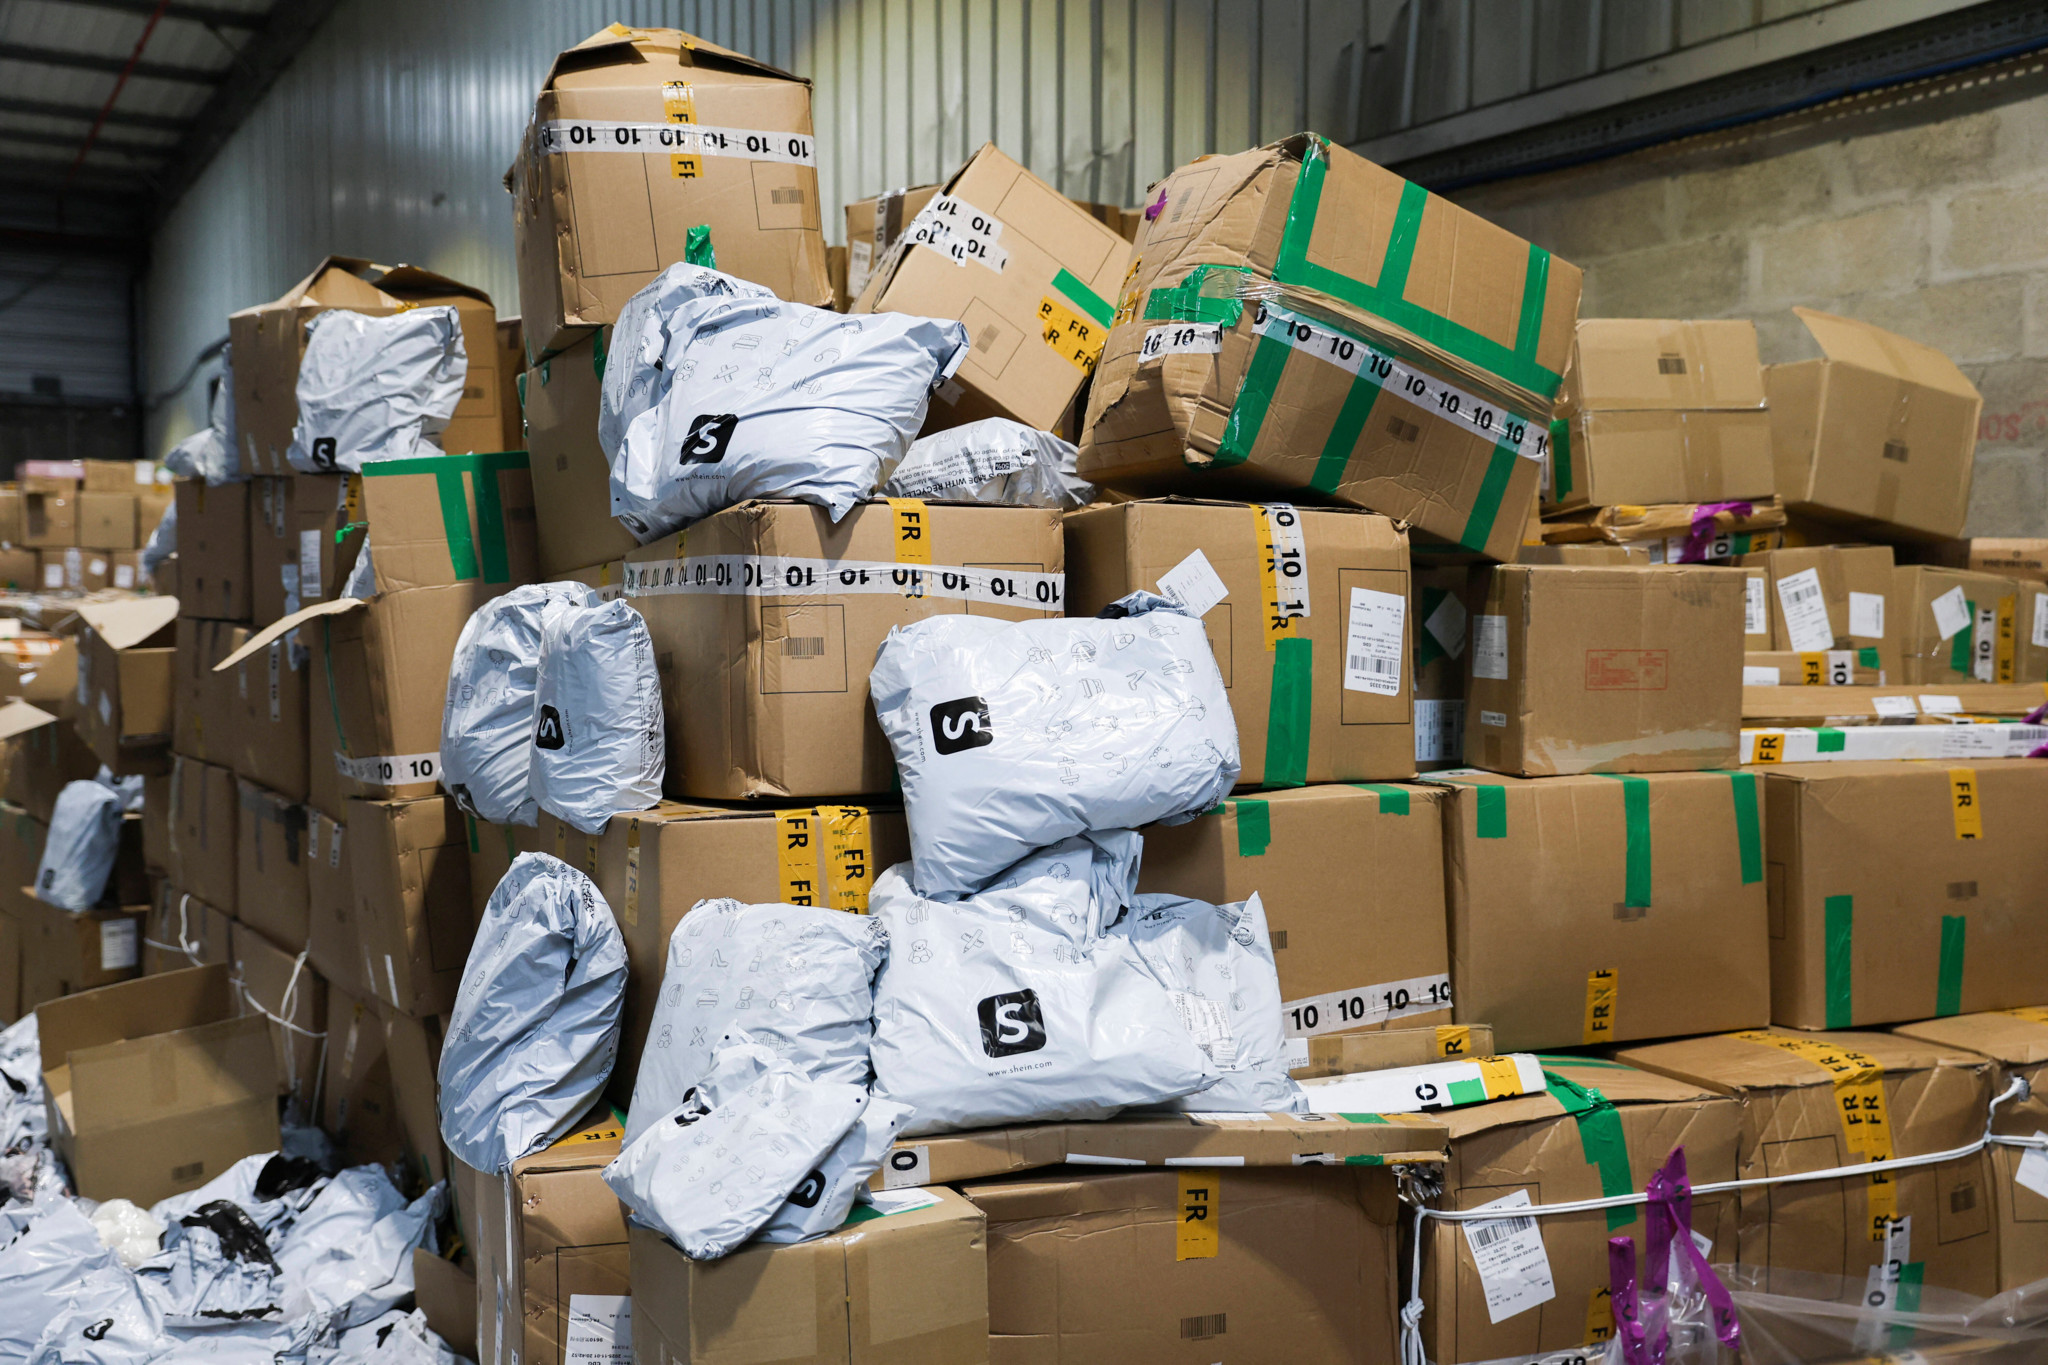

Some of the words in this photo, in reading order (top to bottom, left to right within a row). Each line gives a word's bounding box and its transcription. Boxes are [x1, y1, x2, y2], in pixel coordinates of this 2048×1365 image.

[570, 126, 596, 145] 10
[615, 128, 641, 145] 10
[659, 129, 685, 146] 10
[747, 136, 771, 154] 10
[788, 139, 808, 159] 10
[937, 201, 957, 216] 10
[971, 216, 992, 236] 10
[967, 239, 986, 258] 10
[1068, 320, 1089, 341] FR
[1174, 329, 1195, 346] 10
[1074, 349, 1094, 370] FR
[1286, 320, 1312, 343] 10
[1329, 336, 1355, 361] 10
[1369, 354, 1393, 379] 10
[1404, 374, 1426, 397] 10
[1438, 391, 1460, 414] 10
[1472, 407, 1493, 430] 10
[1505, 421, 1525, 445] 10
[692, 422, 721, 455] S
[945, 478, 965, 487] WITH
[900, 511, 921, 541] FR
[1266, 545, 1284, 573] FR
[1282, 548, 1301, 577] 10
[696, 564, 707, 586] 10
[716, 563, 733, 586] 10
[744, 562, 764, 587] 10
[786, 566, 817, 586] 10
[839, 568, 871, 585] 10
[892, 568, 921, 587] 10
[941, 571, 970, 591] 10
[990, 577, 1018, 598] 10
[1036, 580, 1061, 604] 10
[1270, 602, 1289, 630] FR
[2002, 616, 2011, 639] FR
[1978, 641, 1991, 661] 10
[1806, 661, 1819, 685] FR
[1834, 661, 1847, 685] 10
[2001, 658, 2011, 680] FR
[915, 712, 926, 762] www.shein.com
[942, 711, 980, 740] S
[1759, 736, 1778, 761] FR
[378, 762, 393, 780] 10
[410, 759, 433, 777] 10
[1956, 782, 1972, 808] FR
[787, 818, 808, 850] FR
[844, 849, 865, 881] FR
[1291, 1005, 1320, 1031] 10
[1337, 997, 1365, 1022] 10
[1383, 988, 1410, 1011] 10
[1592, 1003, 1610, 1032] FR
[995, 1003, 1031, 1043] S
[987, 1060, 1053, 1077] www.shein.com
[1820, 1055, 1850, 1073] FR
[1843, 1094, 1863, 1125] FR
[1845, 1053, 1875, 1069] FR
[1863, 1095, 1881, 1125] FR
[584, 1130, 618, 1141] FR
[1185, 1188, 1209, 1224] FR
